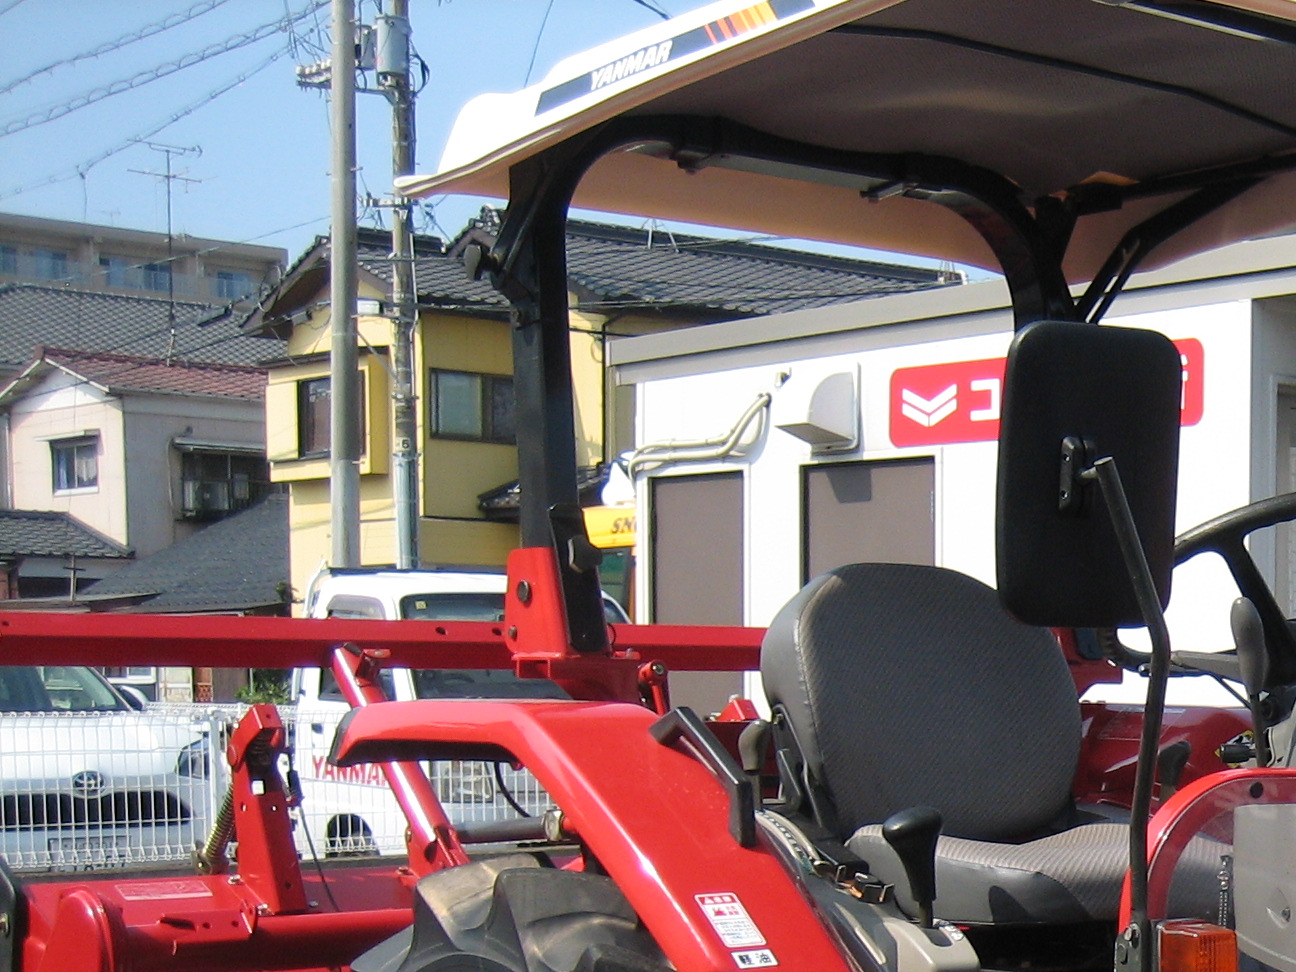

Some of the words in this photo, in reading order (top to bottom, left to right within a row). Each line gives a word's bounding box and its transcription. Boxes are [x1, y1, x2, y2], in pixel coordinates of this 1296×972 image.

[590, 39, 674, 91] YANMAR
[611, 516, 636, 534] SN
[311, 755, 388, 786] YANMA
